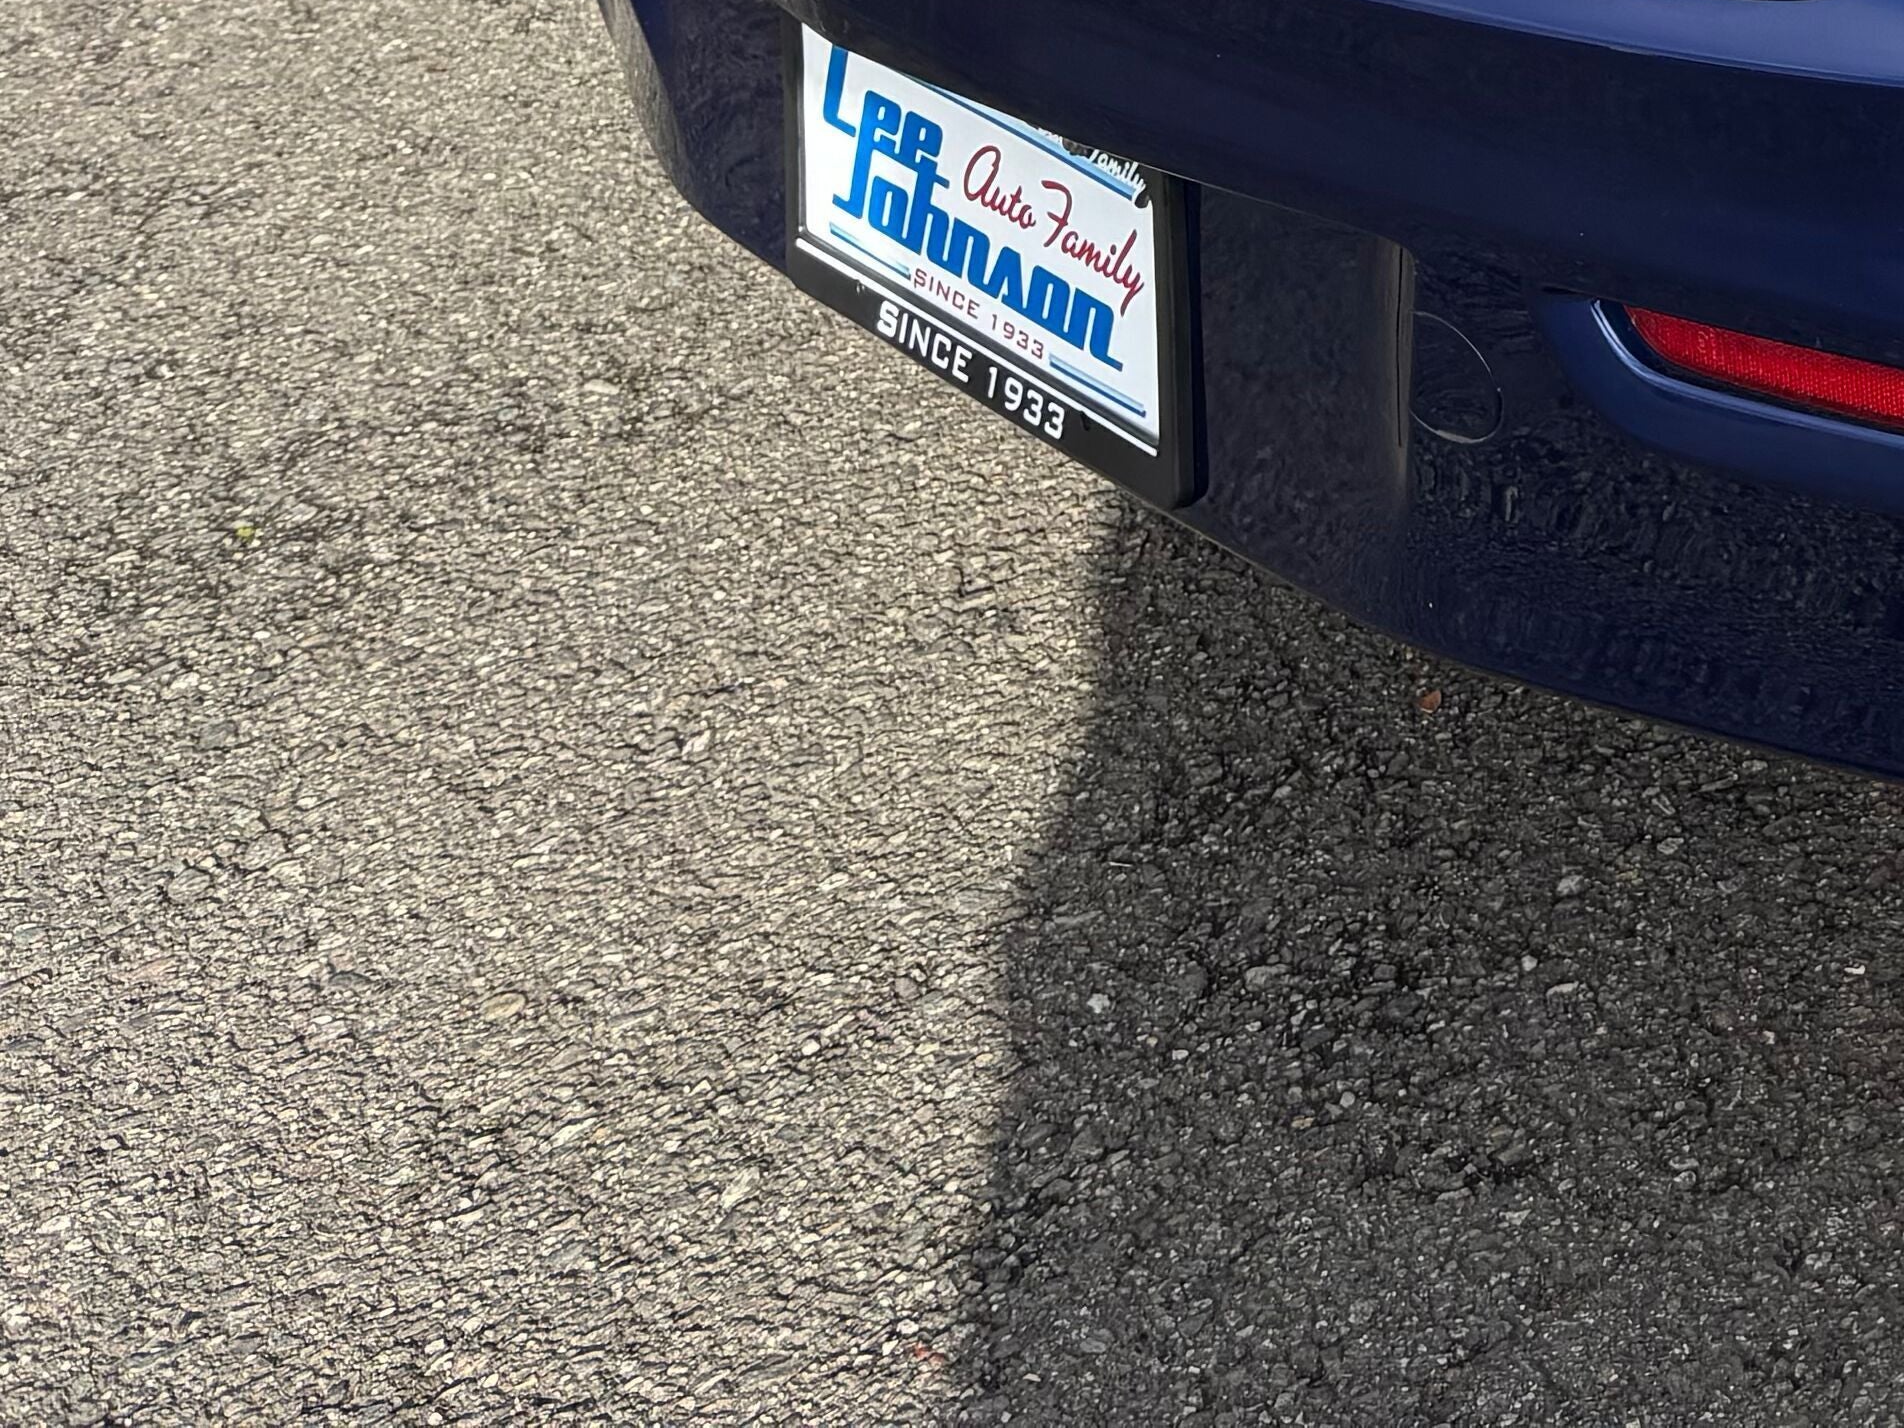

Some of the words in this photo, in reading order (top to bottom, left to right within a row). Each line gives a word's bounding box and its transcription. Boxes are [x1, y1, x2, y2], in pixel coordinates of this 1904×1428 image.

[823, 44, 944, 167] Lee
[832, 129, 1123, 371] Johnson
[963, 144, 1037, 228] Auto
[1041, 179, 1145, 316] Family
[875, 301, 973, 384] SINCE
[987, 366, 1065, 440] 1933
[912, 267, 981, 321] SINCE
[991, 313, 1045, 360] 1933
